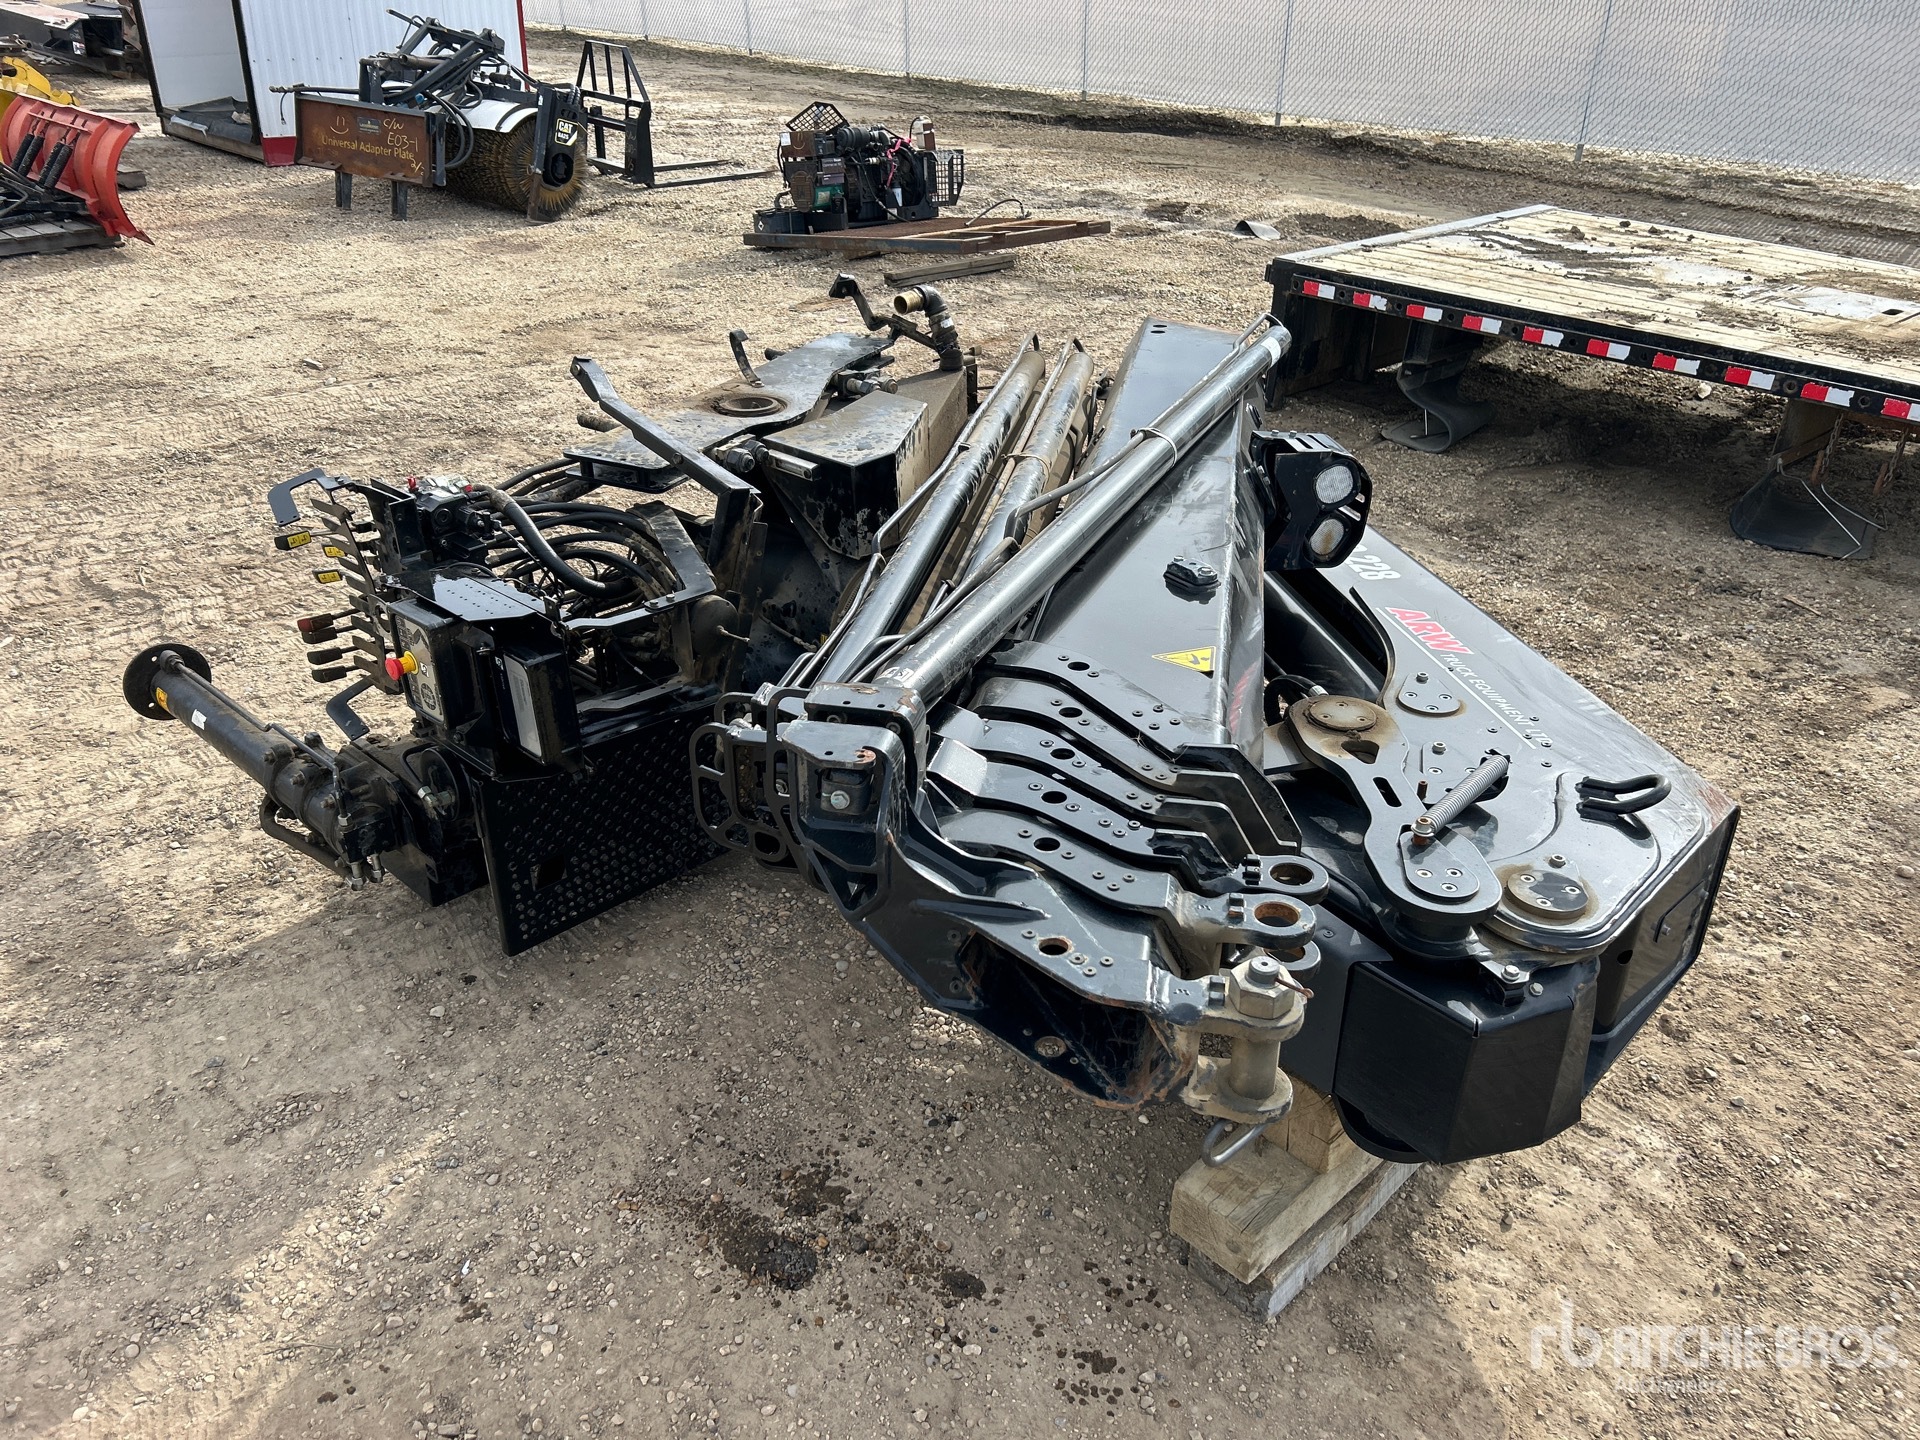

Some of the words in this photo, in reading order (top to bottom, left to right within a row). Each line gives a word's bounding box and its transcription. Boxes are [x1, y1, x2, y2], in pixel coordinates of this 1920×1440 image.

[558, 121, 574, 134] CAT
[321, 135, 358, 150] Universal
[359, 141, 392, 157] Adapter
[393, 147, 415, 160] Plate
[1344, 554, 1402, 581] 228
[1385, 606, 1475, 655] ARW
[1440, 653, 1478, 678] TRUCK
[1468, 679, 1536, 727] EQUIPMENT
